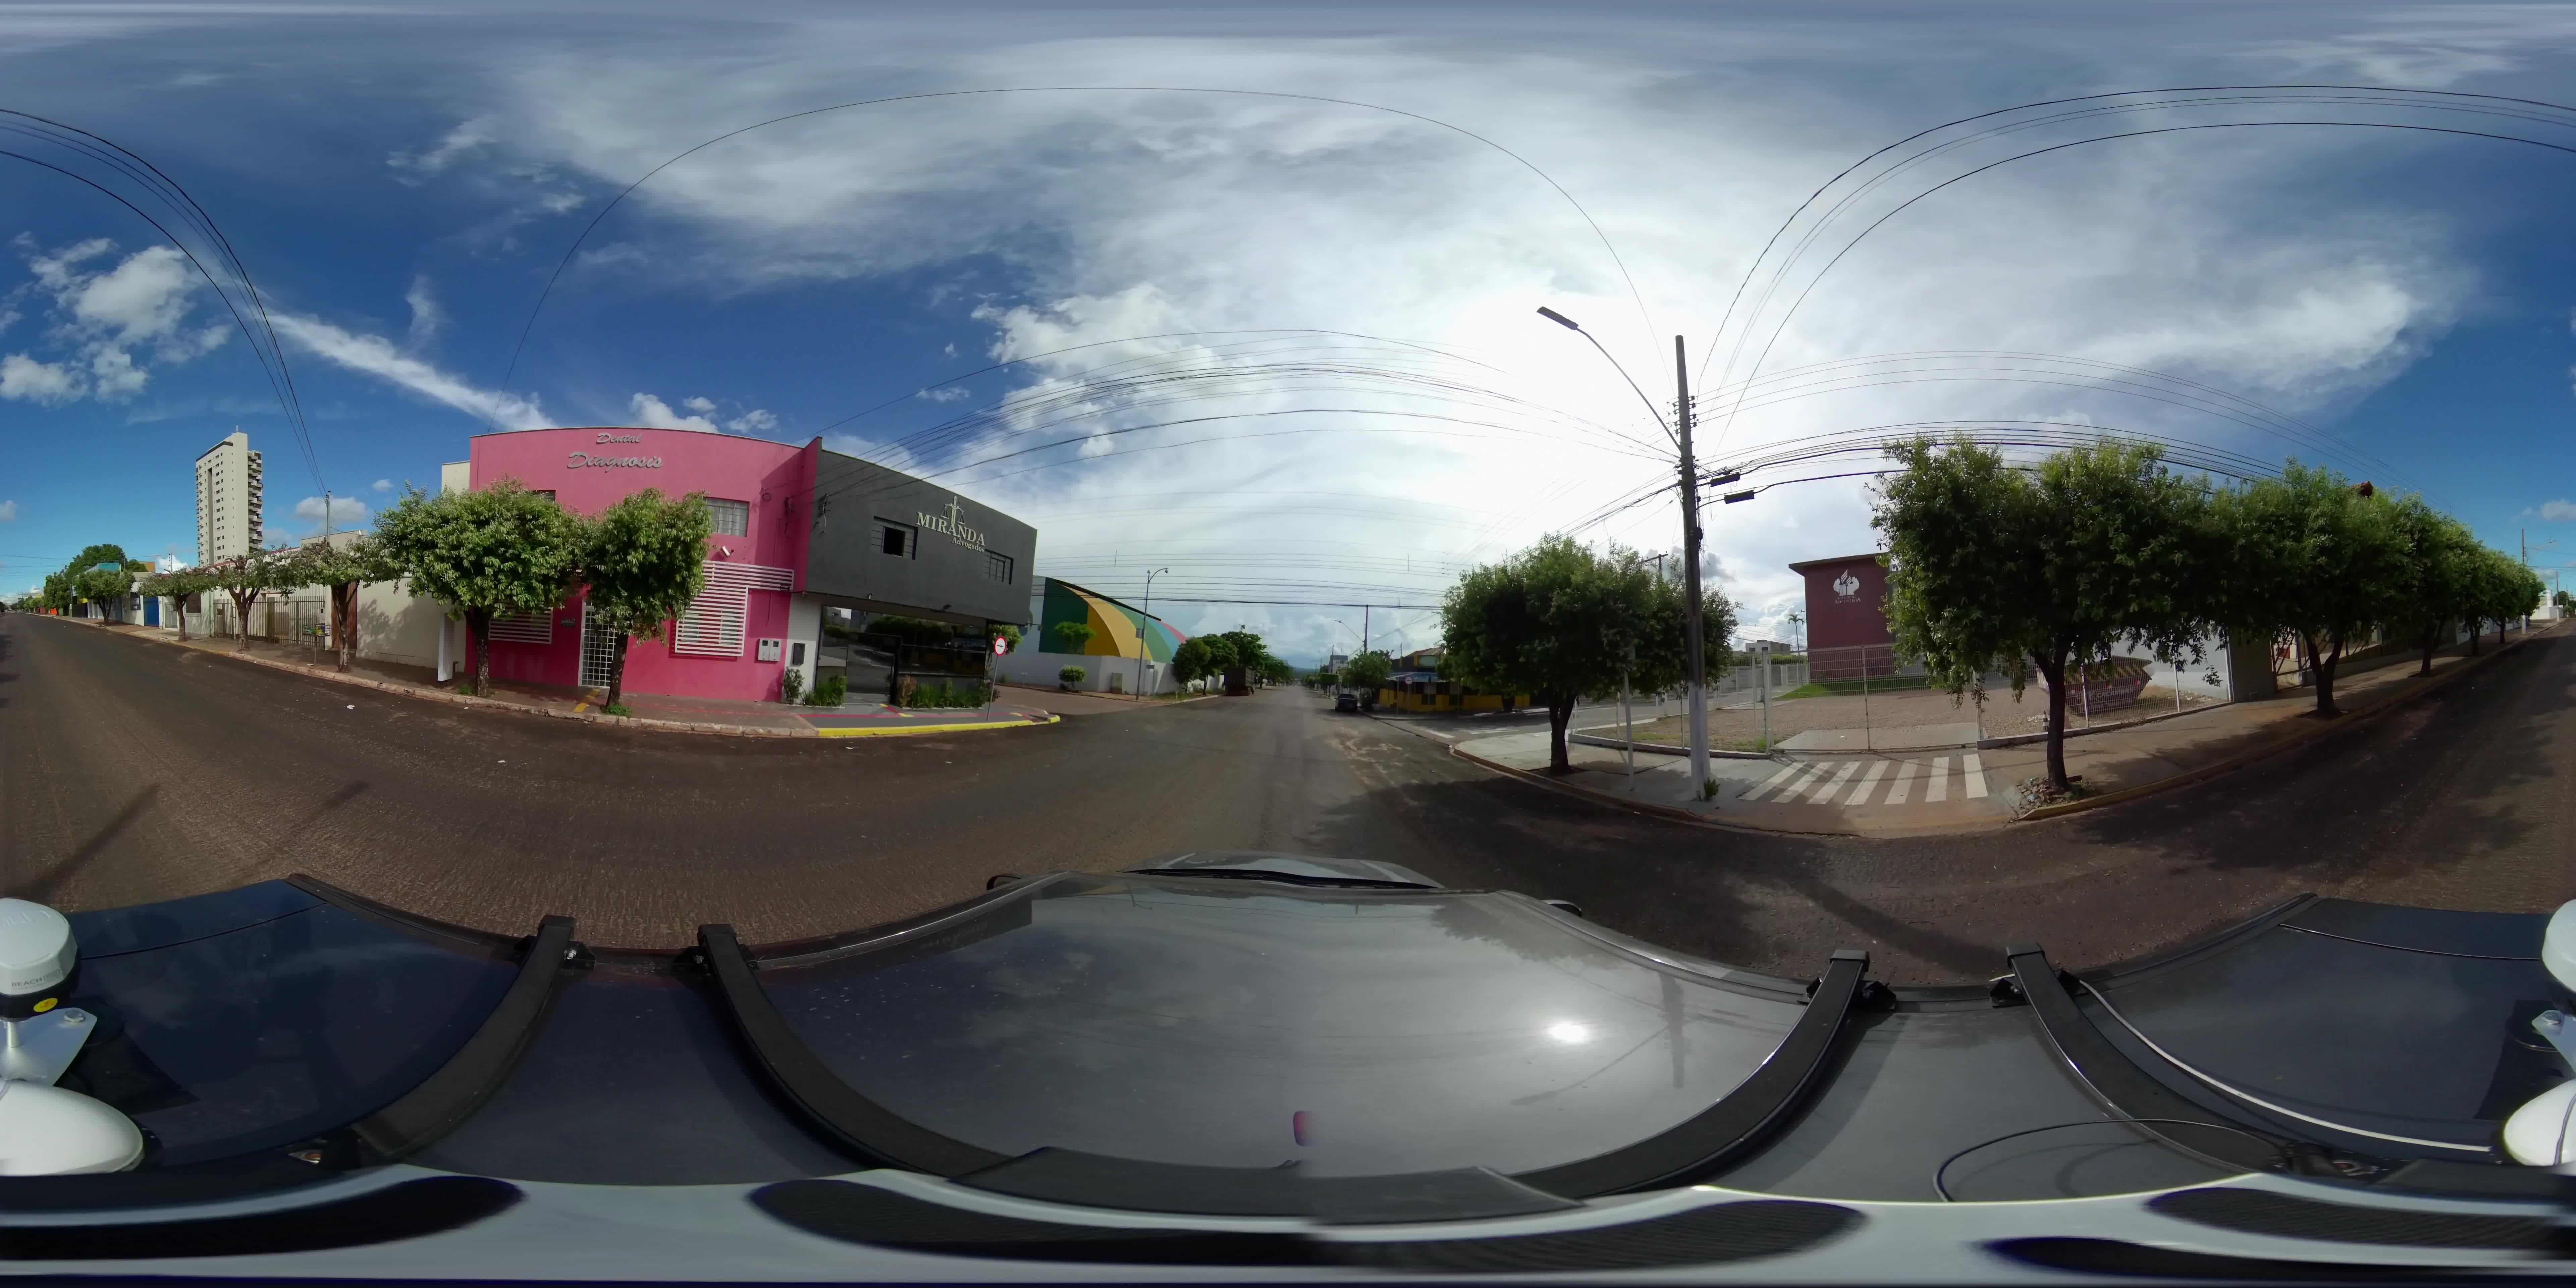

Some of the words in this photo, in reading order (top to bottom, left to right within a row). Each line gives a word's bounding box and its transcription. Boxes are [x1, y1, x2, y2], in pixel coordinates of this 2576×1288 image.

[596, 432, 641, 444] Dental
[567, 451, 663, 473] Diagnosis
[916, 512, 985, 546] MIRANDA
[12, 977, 42, 987] REACH
